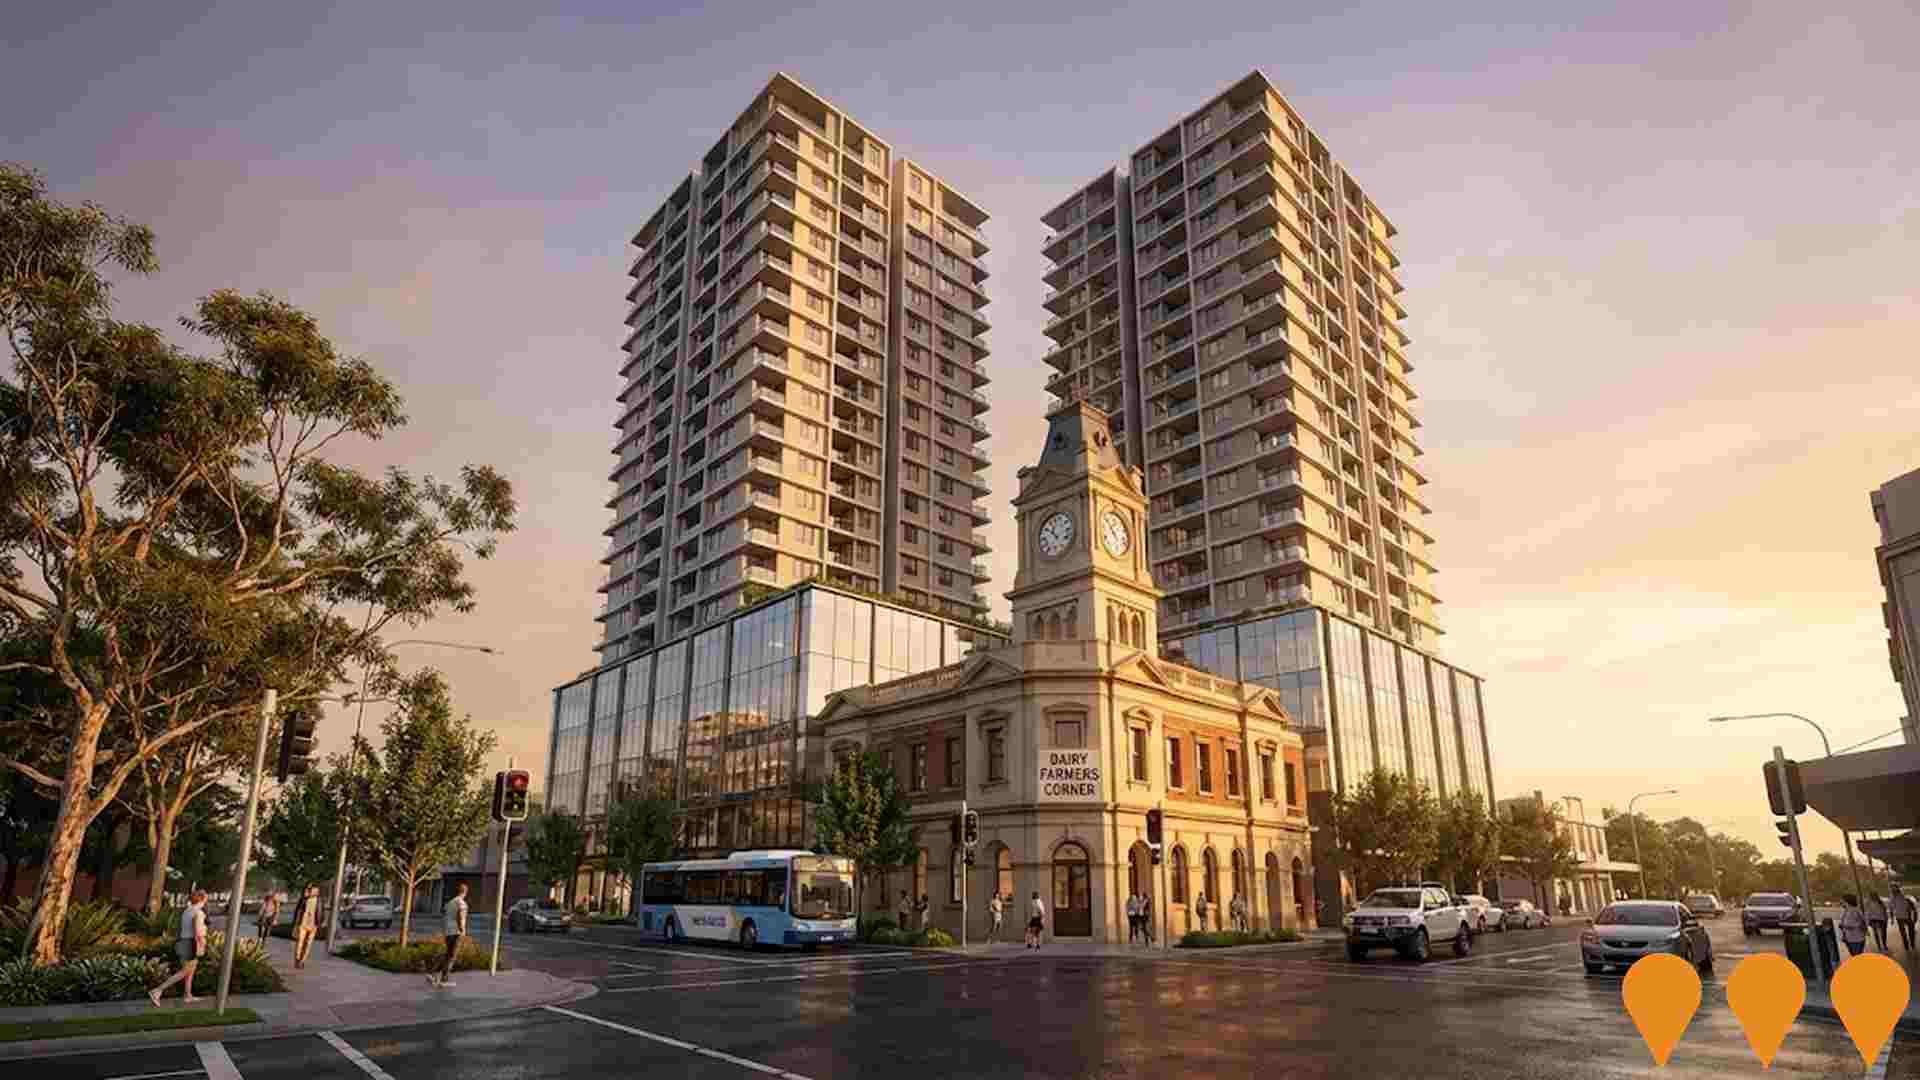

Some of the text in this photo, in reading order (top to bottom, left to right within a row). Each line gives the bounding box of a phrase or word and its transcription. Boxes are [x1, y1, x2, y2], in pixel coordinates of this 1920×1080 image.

[1050, 752, 1088, 766] DAIRY
[1040, 768, 1100, 781] FARMERS
[1044, 783, 1095, 796] CORNER
